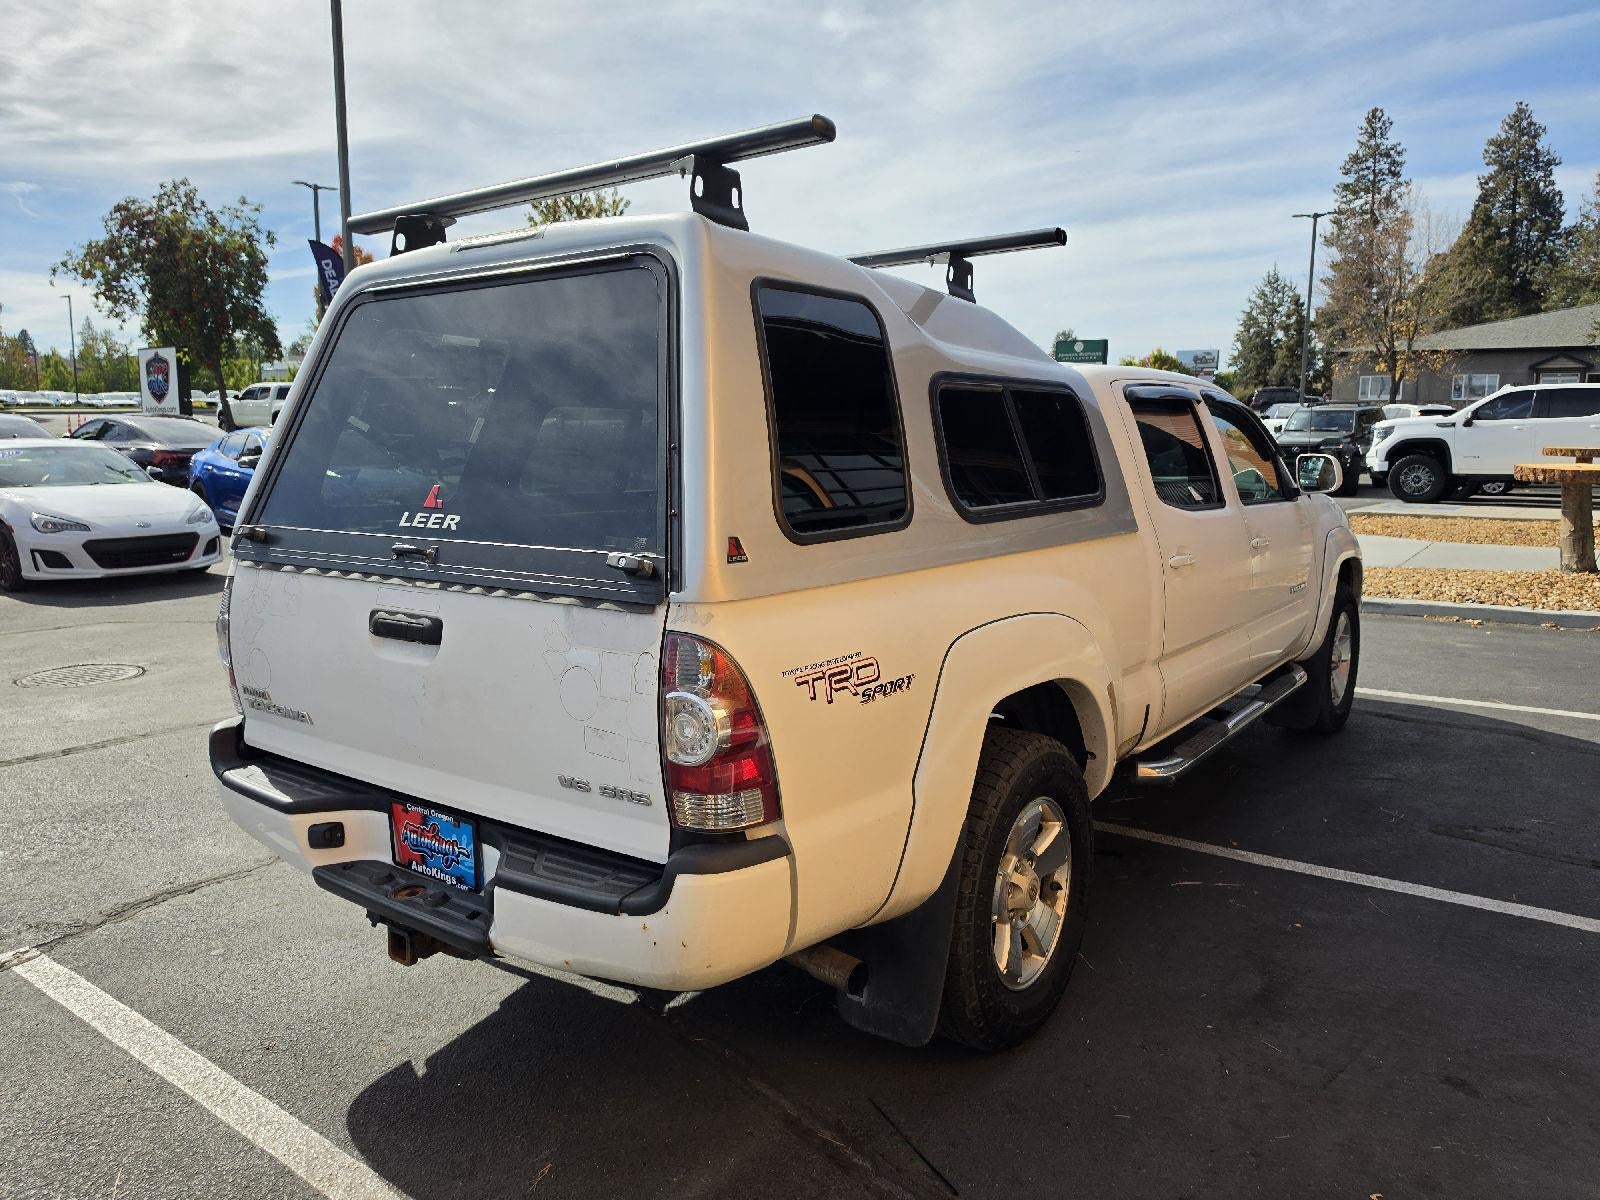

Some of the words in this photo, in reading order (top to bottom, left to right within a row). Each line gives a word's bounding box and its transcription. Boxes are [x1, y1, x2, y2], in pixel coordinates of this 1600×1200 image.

[399, 511, 460, 531] LEER
[794, 656, 880, 704] TRD
[859, 673, 915, 705] SPORT
[244, 696, 314, 726] TACOMA
[557, 774, 592, 793] V6
[406, 803, 430, 816] Central
[430, 809, 455, 824] Oregon
